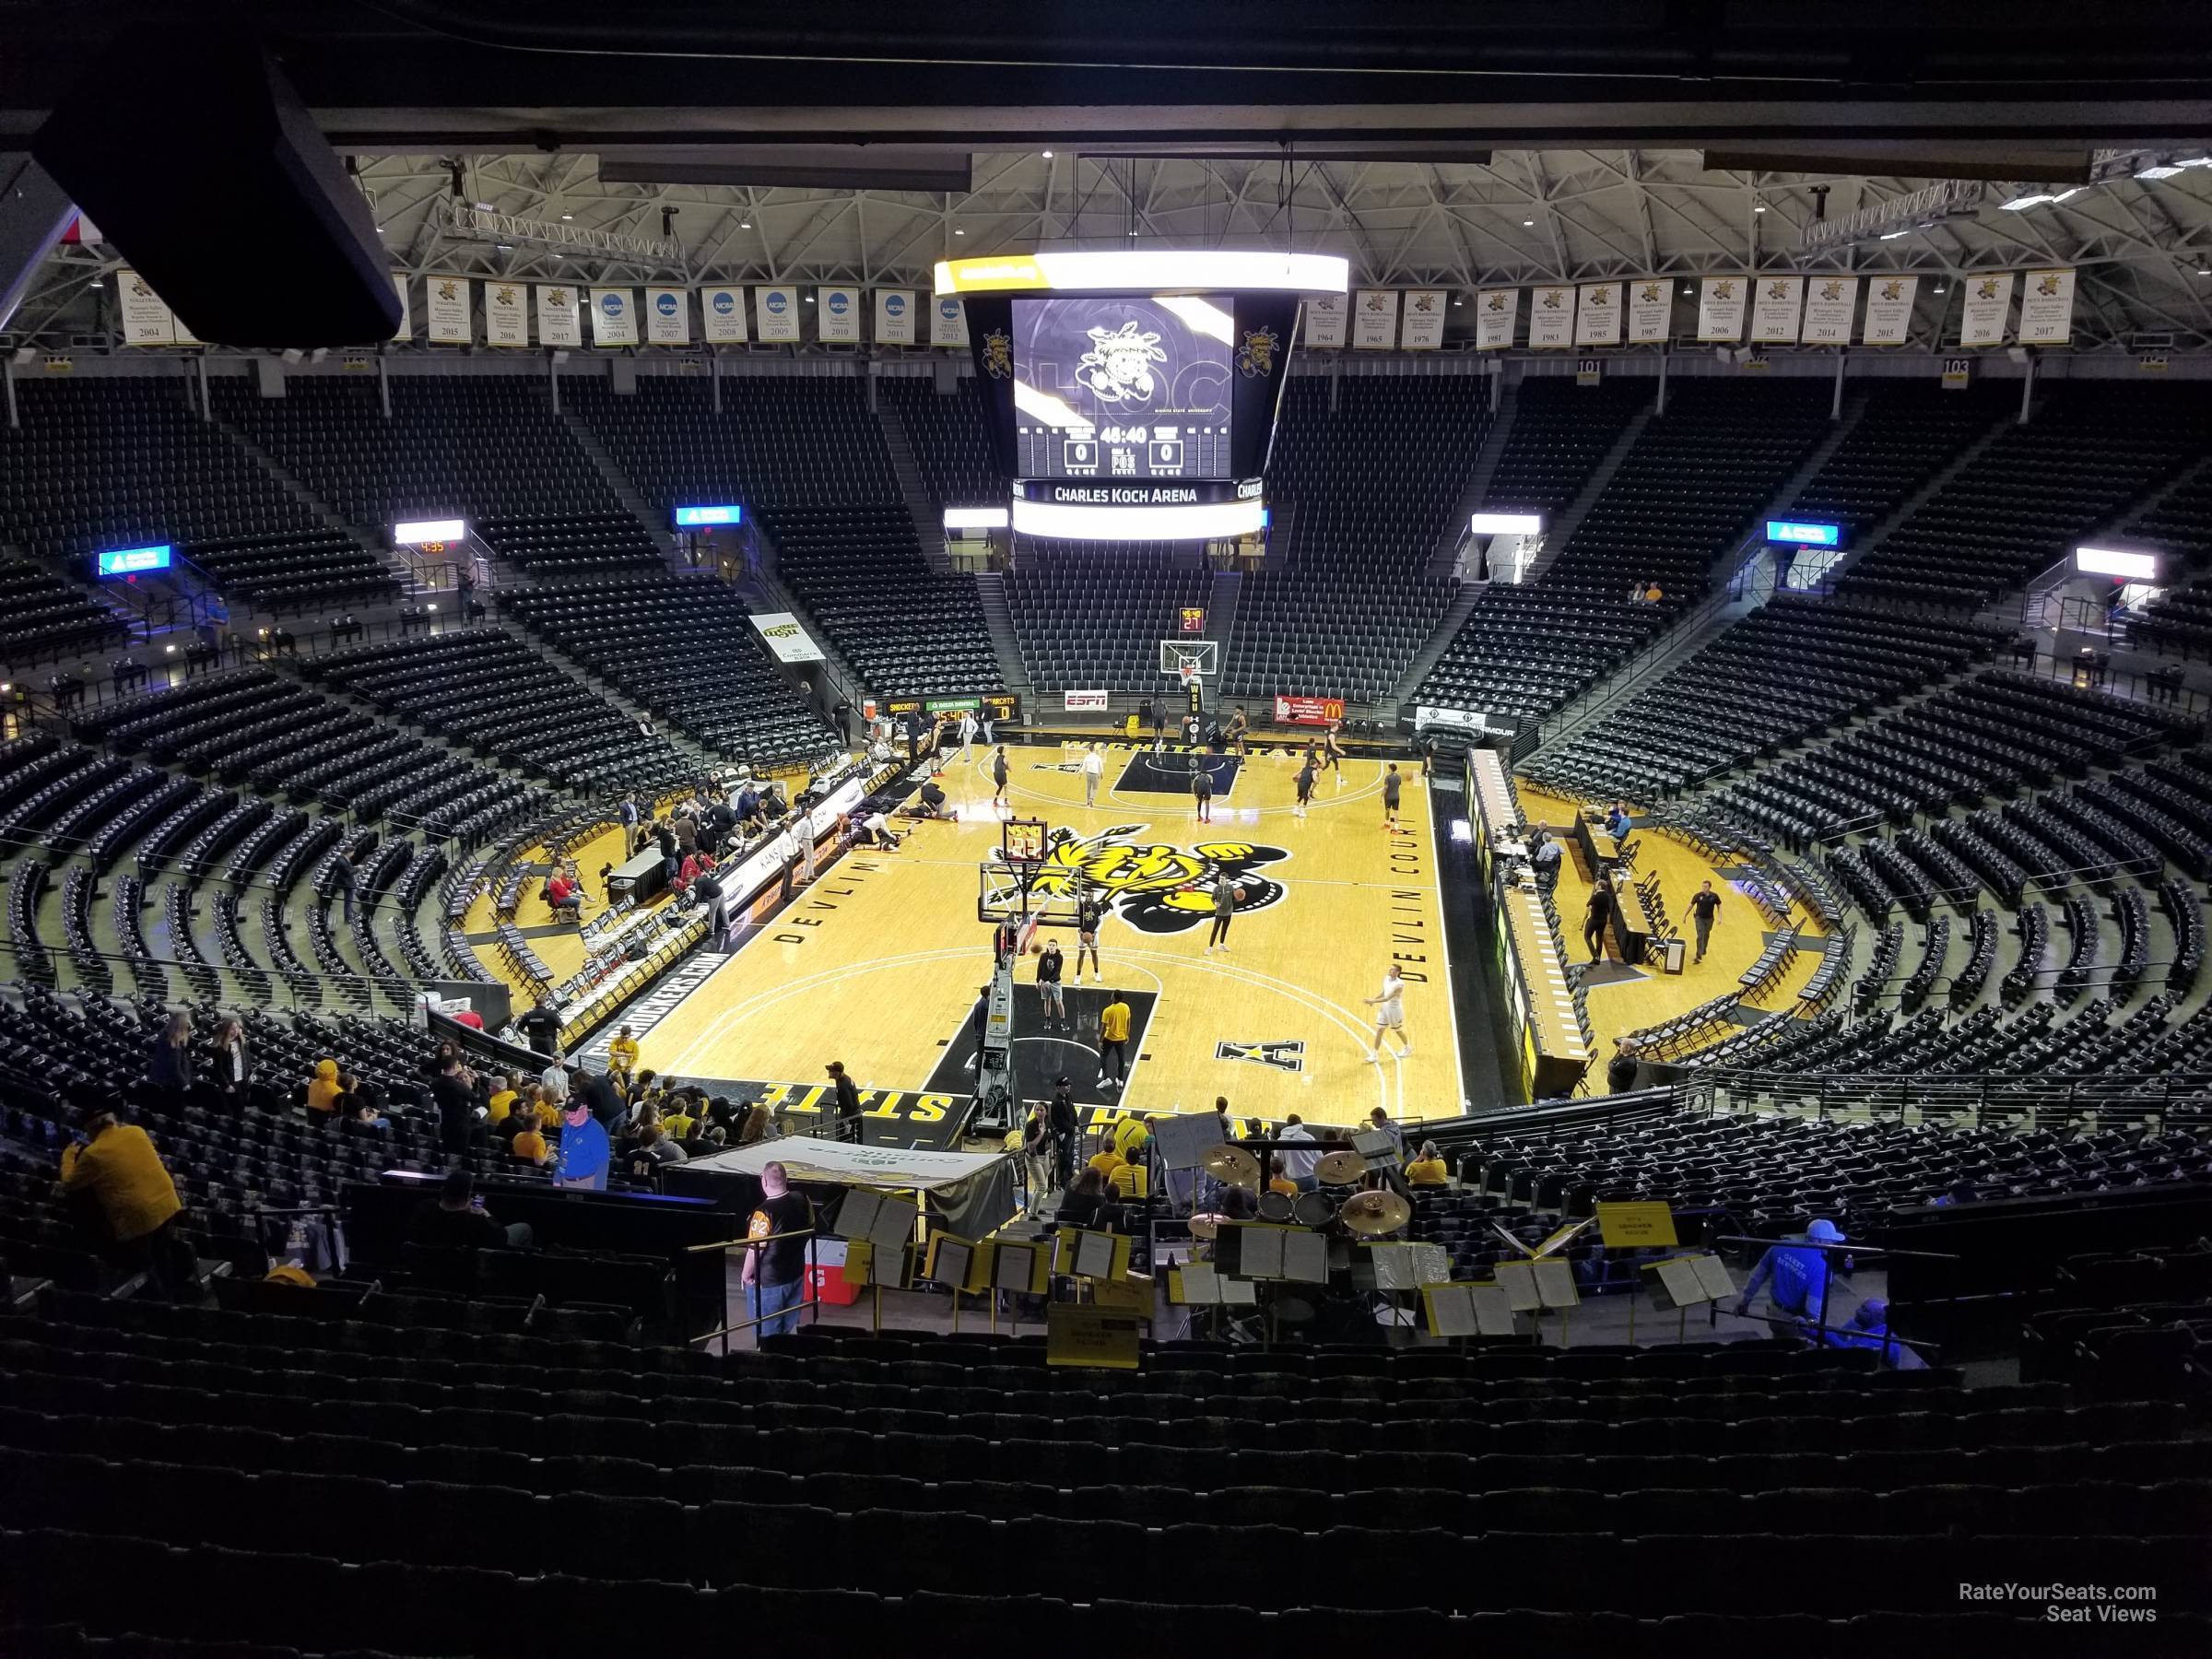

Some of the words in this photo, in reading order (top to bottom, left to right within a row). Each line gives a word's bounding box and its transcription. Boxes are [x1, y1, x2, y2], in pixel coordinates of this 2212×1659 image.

[140, 328, 159, 337] 2004
[442, 327, 458, 336] 2015
[607, 331, 625, 339] 2004
[771, 327, 788, 335] 2009
[1590, 330, 1607, 338] 1985
[1641, 328, 1657, 336] 1987
[1711, 326, 1729, 335] 2006
[1765, 327, 1784, 335] 2012
[1817, 328, 1836, 336] 2014
[1877, 328, 1894, 337] 2015
[1973, 330, 1990, 338] 2016
[2035, 326, 2054, 335] 2017
[500, 332, 516, 340] 2016
[1579, 360, 1600, 372] 101
[1945, 360, 1970, 373] 103
[1076, 444, 1087, 461] 0
[1160, 444, 1172, 461] 0
[1055, 487, 1109, 502] CHARLES
[1112, 488, 1147, 503] KOCH
[1151, 488, 1197, 502] ARENA
[421, 540, 443, 552] 4:35
[1184, 618, 1198, 629] 27
[991, 697, 1015, 705] ARCATS
[1066, 695, 1106, 706] ESPN
[1190, 685, 1199, 712] WSU
[940, 711, 964, 721] 5:40
[1002, 706, 1010, 719] 0
[1007, 826, 1040, 837] 45:40
[1390, 817, 1419, 875] COURT
[773, 862, 879, 945] DEVLIN
[1392, 890, 1428, 982] DEVLIN
[750, 1219, 768, 1235] 32
